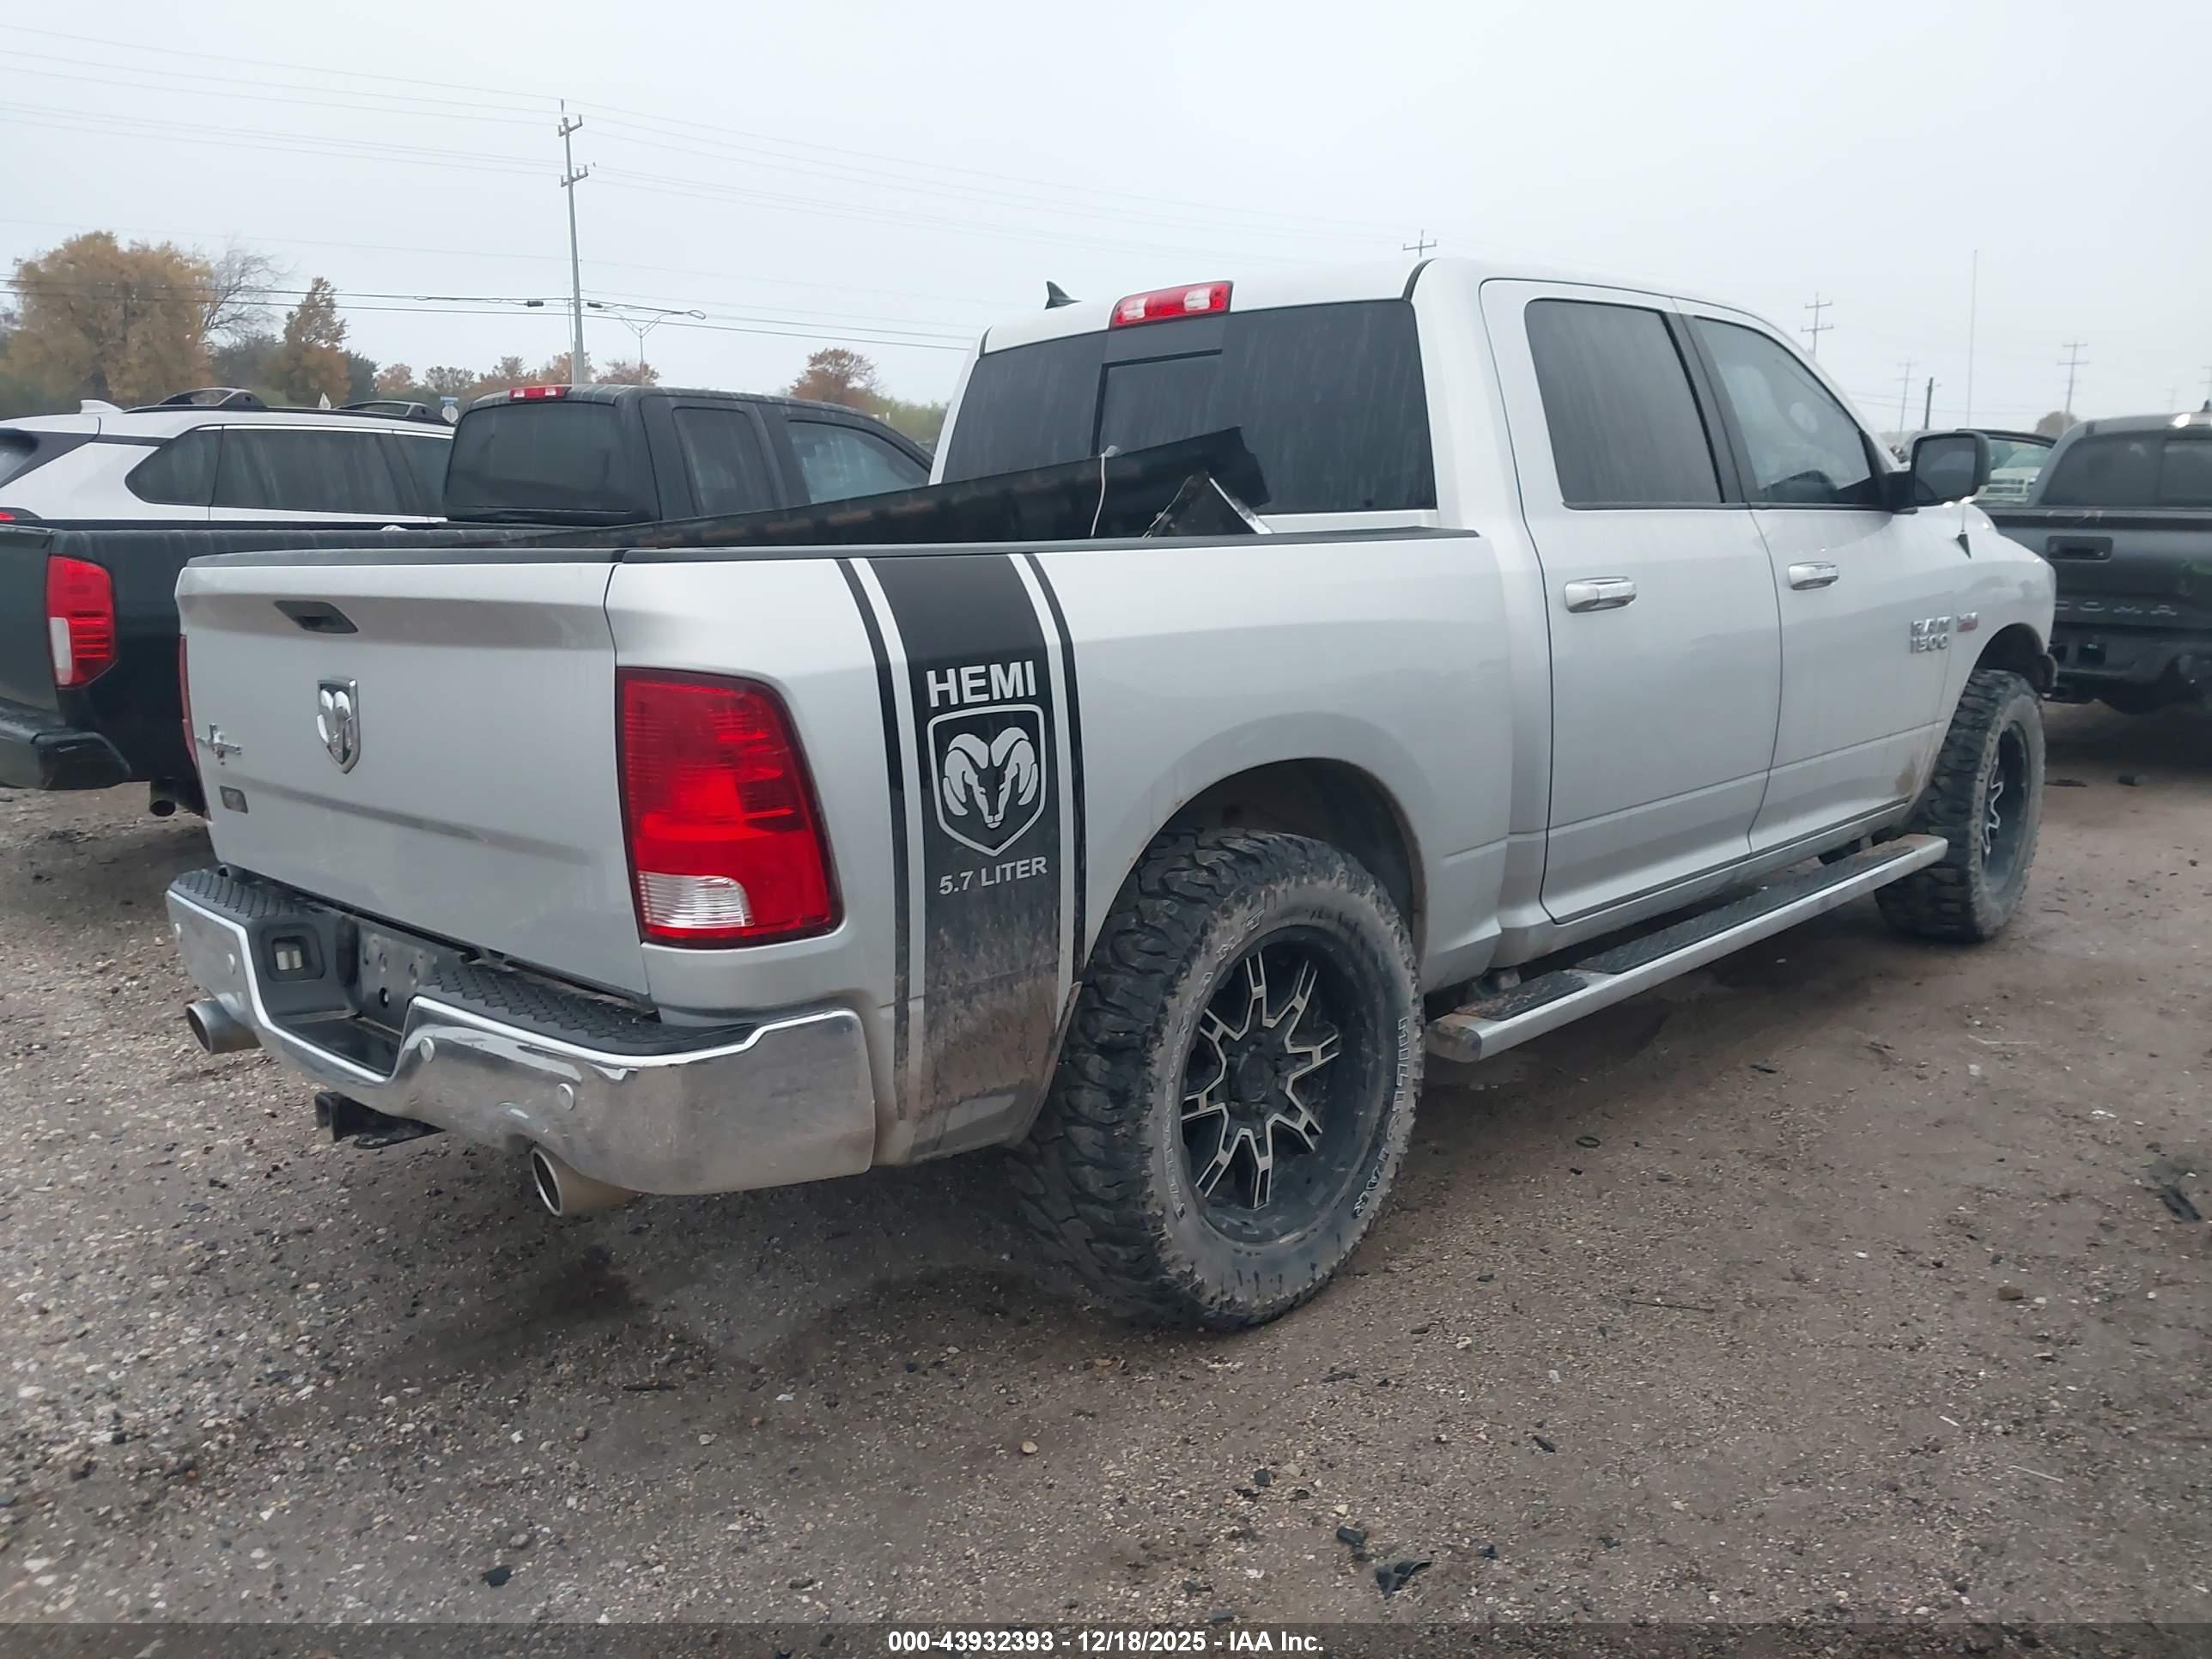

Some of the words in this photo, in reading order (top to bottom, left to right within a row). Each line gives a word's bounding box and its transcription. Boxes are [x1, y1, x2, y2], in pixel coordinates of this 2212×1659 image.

[1911, 617, 1951, 637] RAM
[1910, 635, 1948, 653] 1500
[926, 659, 1037, 708] HEMI
[939, 870, 974, 895] 5.7
[980, 856, 1048, 887] LITER
